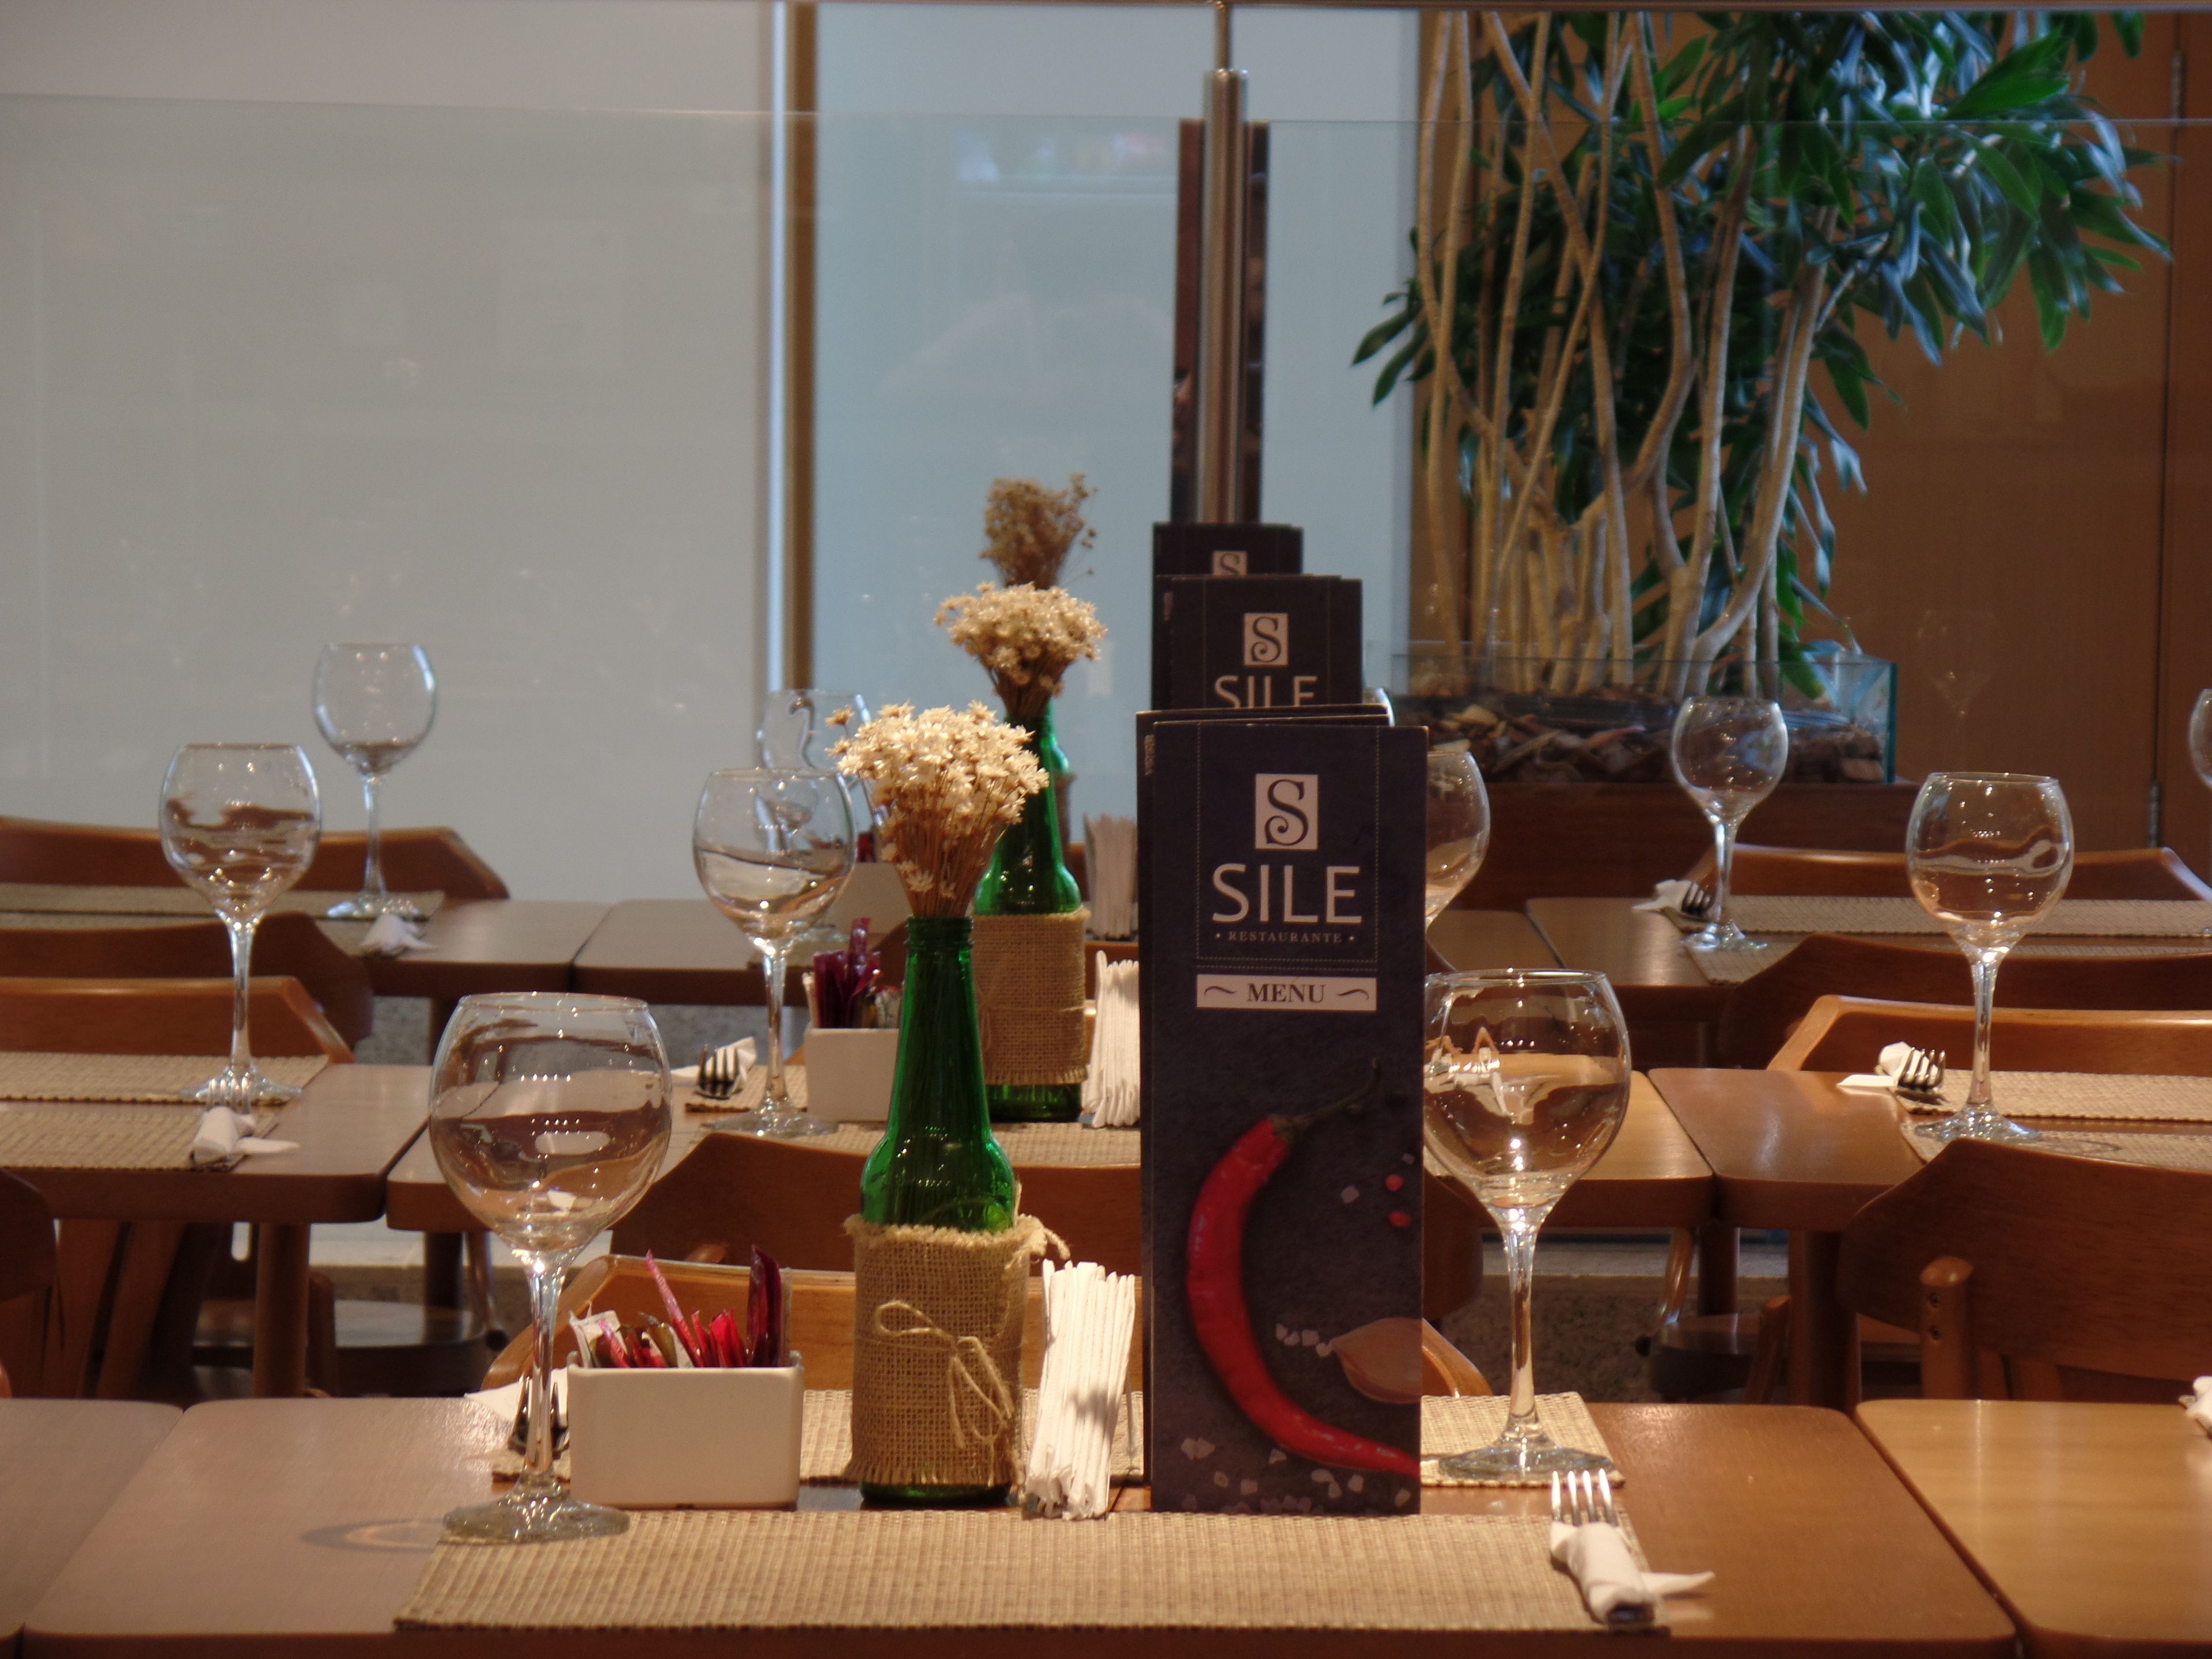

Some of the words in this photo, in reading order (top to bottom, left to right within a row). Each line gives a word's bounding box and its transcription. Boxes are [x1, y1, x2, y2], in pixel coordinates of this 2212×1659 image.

[1251, 616, 1281, 662] S
[1214, 675, 1317, 709] SILE
[1264, 779, 1308, 846] S
[1212, 863, 1362, 923] SILE
[1228, 931, 1342, 943] RESTAURANTE
[1247, 983, 1325, 1003] MENU
